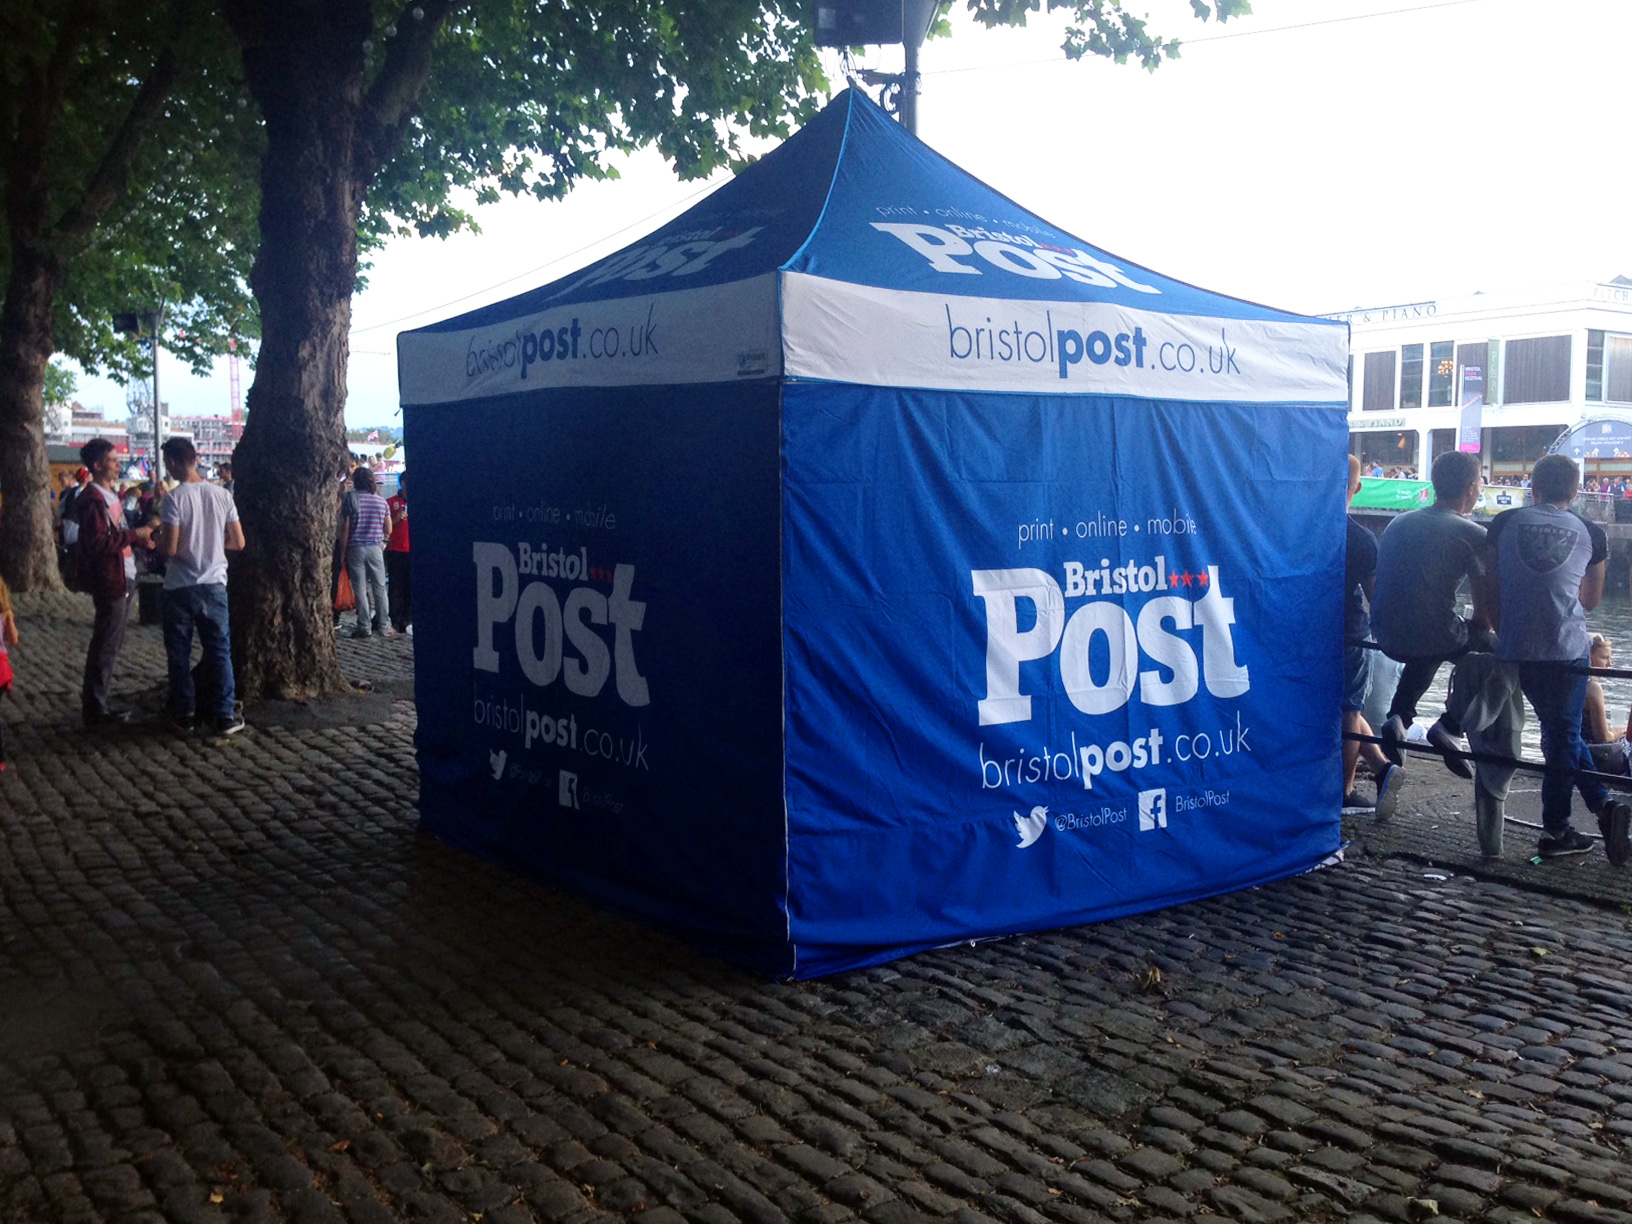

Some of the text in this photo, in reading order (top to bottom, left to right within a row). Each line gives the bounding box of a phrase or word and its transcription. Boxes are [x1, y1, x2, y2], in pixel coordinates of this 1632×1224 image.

[875, 205, 917, 218] print
[935, 206, 987, 224] online
[944, 223, 1045, 249] Bristol
[869, 222, 1163, 295] Post
[465, 303, 659, 380] bristolpost.co.uk
[946, 304, 1241, 379] bristolpost.co.uk
[1382, 304, 1438, 322] PIANO
[1018, 508, 1198, 550] print online mobile
[517, 541, 589, 582] Bristol
[1063, 555, 1168, 598] Bristol
[472, 541, 651, 707] Post
[971, 564, 1251, 726] Post
[473, 682, 650, 771] bristolpost.co.uk
[980, 710, 1252, 790] bristolpost.co.uk
[1054, 806, 1128, 832] @BristolPost
[1175, 790, 1230, 813] BristolPost
